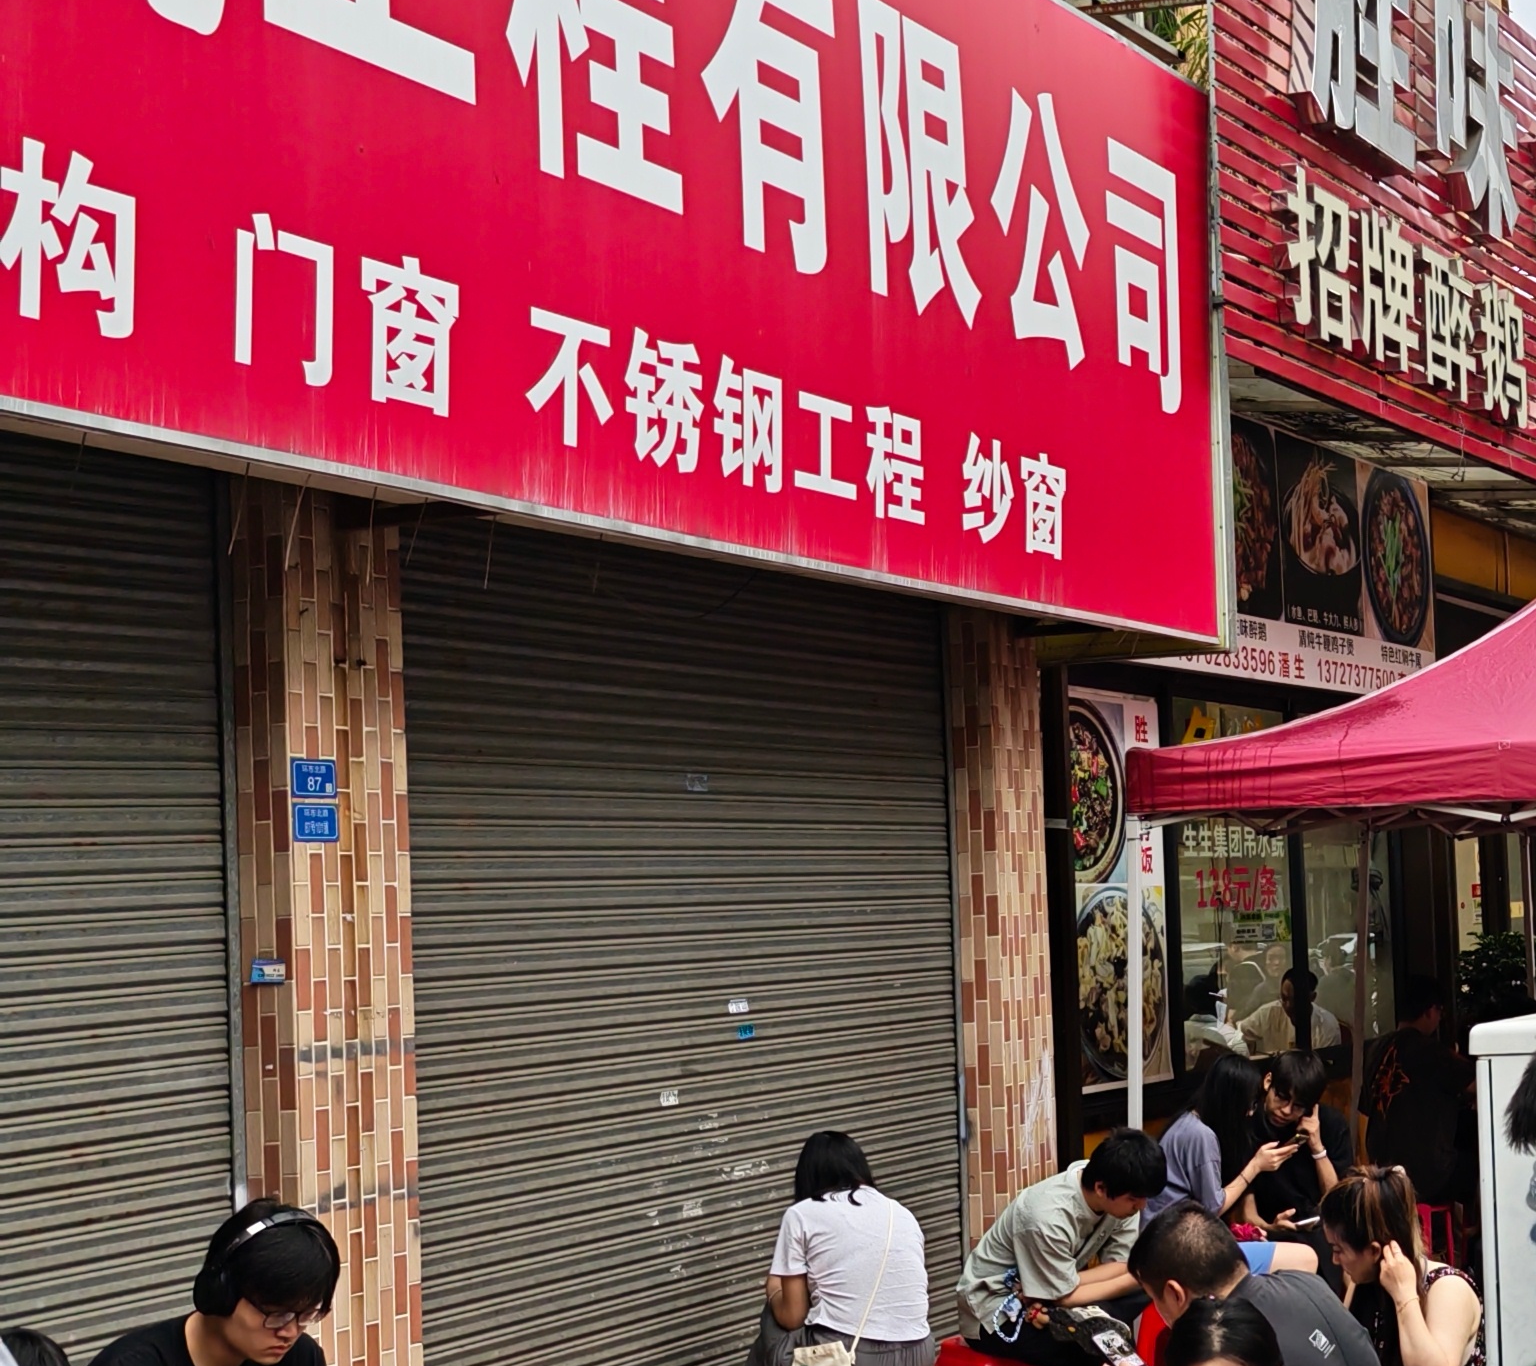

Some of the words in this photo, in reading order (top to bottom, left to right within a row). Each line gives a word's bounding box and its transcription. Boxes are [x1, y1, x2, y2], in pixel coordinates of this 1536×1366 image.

[1287, 164, 1527, 428] 招牌醉鹅
[0, 138, 136, 339] 构
[235, 214, 460, 417] 门窗
[526, 306, 927, 528] 不锈钢工程
[961, 433, 1066, 561] 纱窗
[1237, 619, 1267, 641] 味醉鹅
[1179, 646, 1275, 675] 2833596
[307, 776, 322, 791] 87
